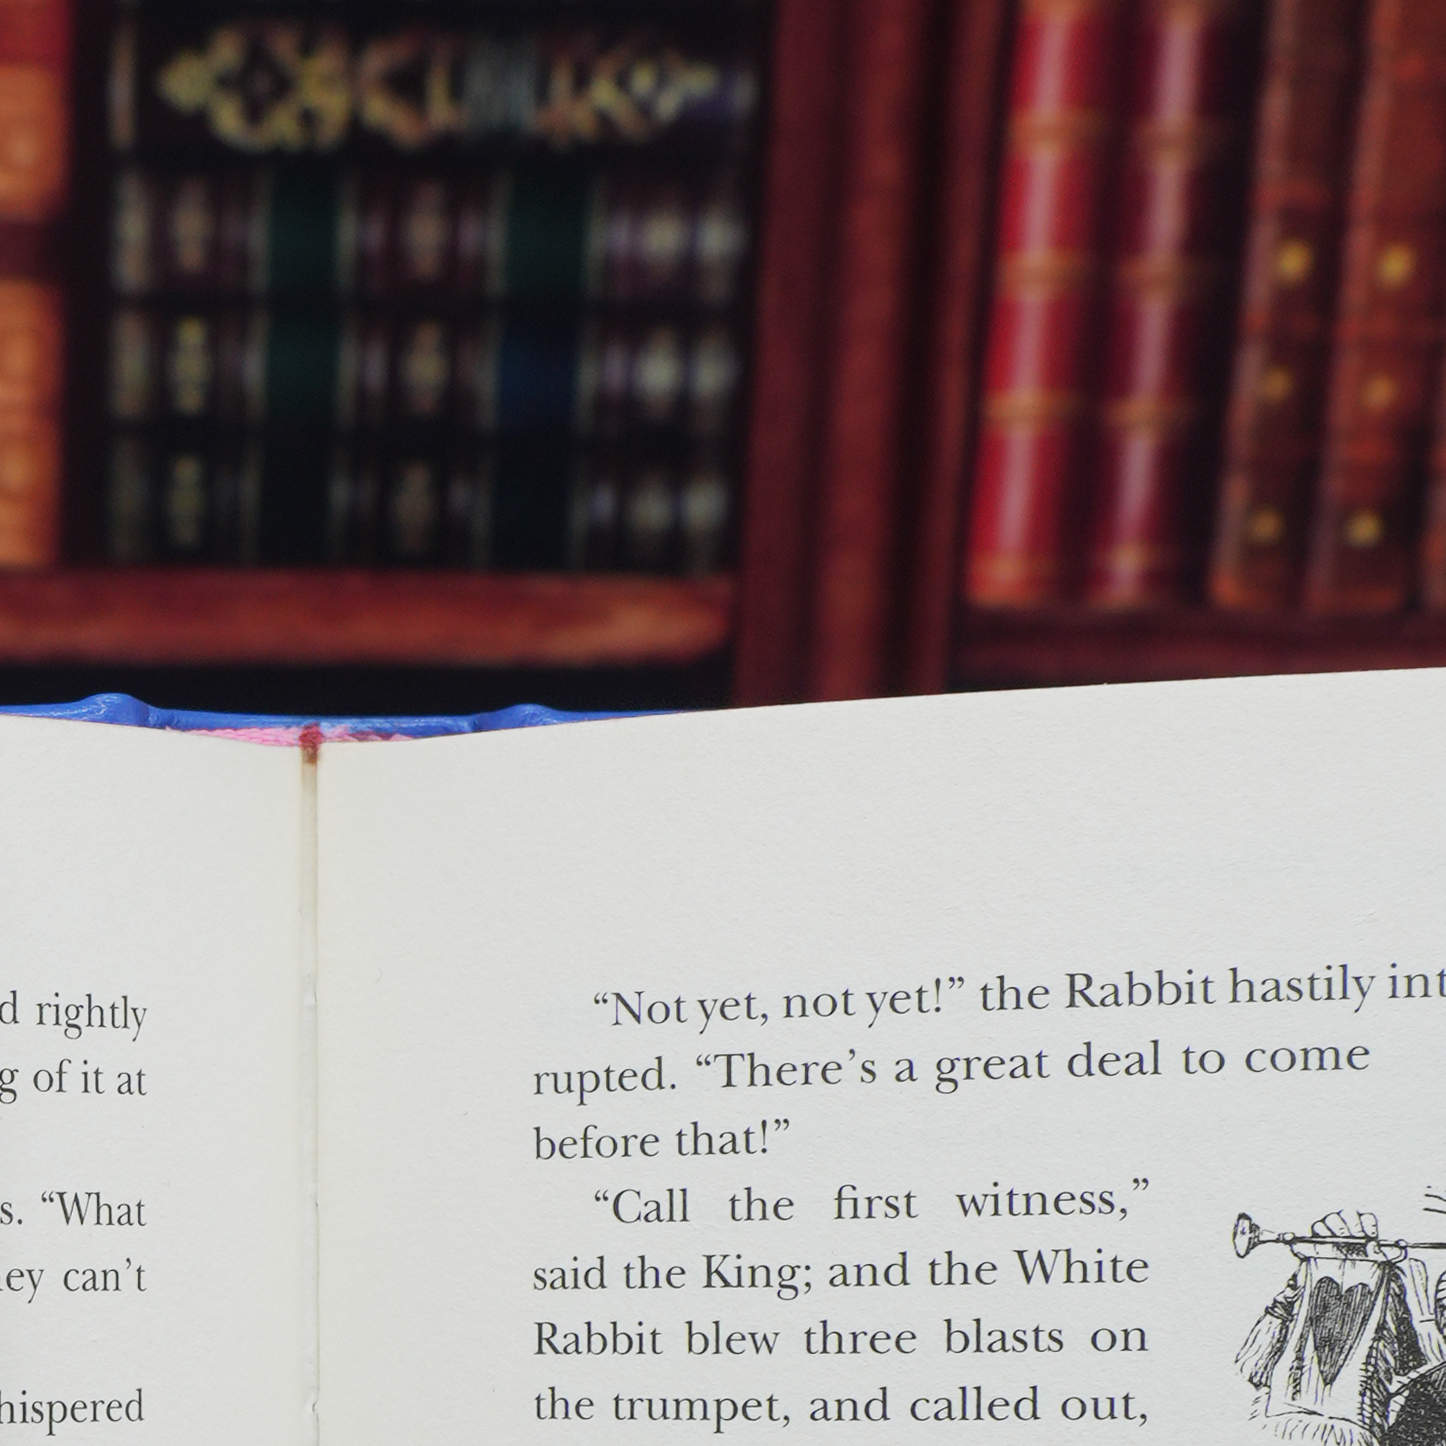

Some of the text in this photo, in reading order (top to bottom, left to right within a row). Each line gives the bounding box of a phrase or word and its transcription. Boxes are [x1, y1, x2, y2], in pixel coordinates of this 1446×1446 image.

[36, 992, 147, 1042] rightly
[594, 964, 1376, 1034] “Not yet, not yet!” the Rabbit hastily
[534, 1039, 1369, 1106] rupted. “There’s a great deal to come
[42, 1191, 146, 1226] “What
[595, 1178, 1149, 1223] “Call the first witness,”
[534, 1318, 1148, 1355] Rabbit blew three blasts on
